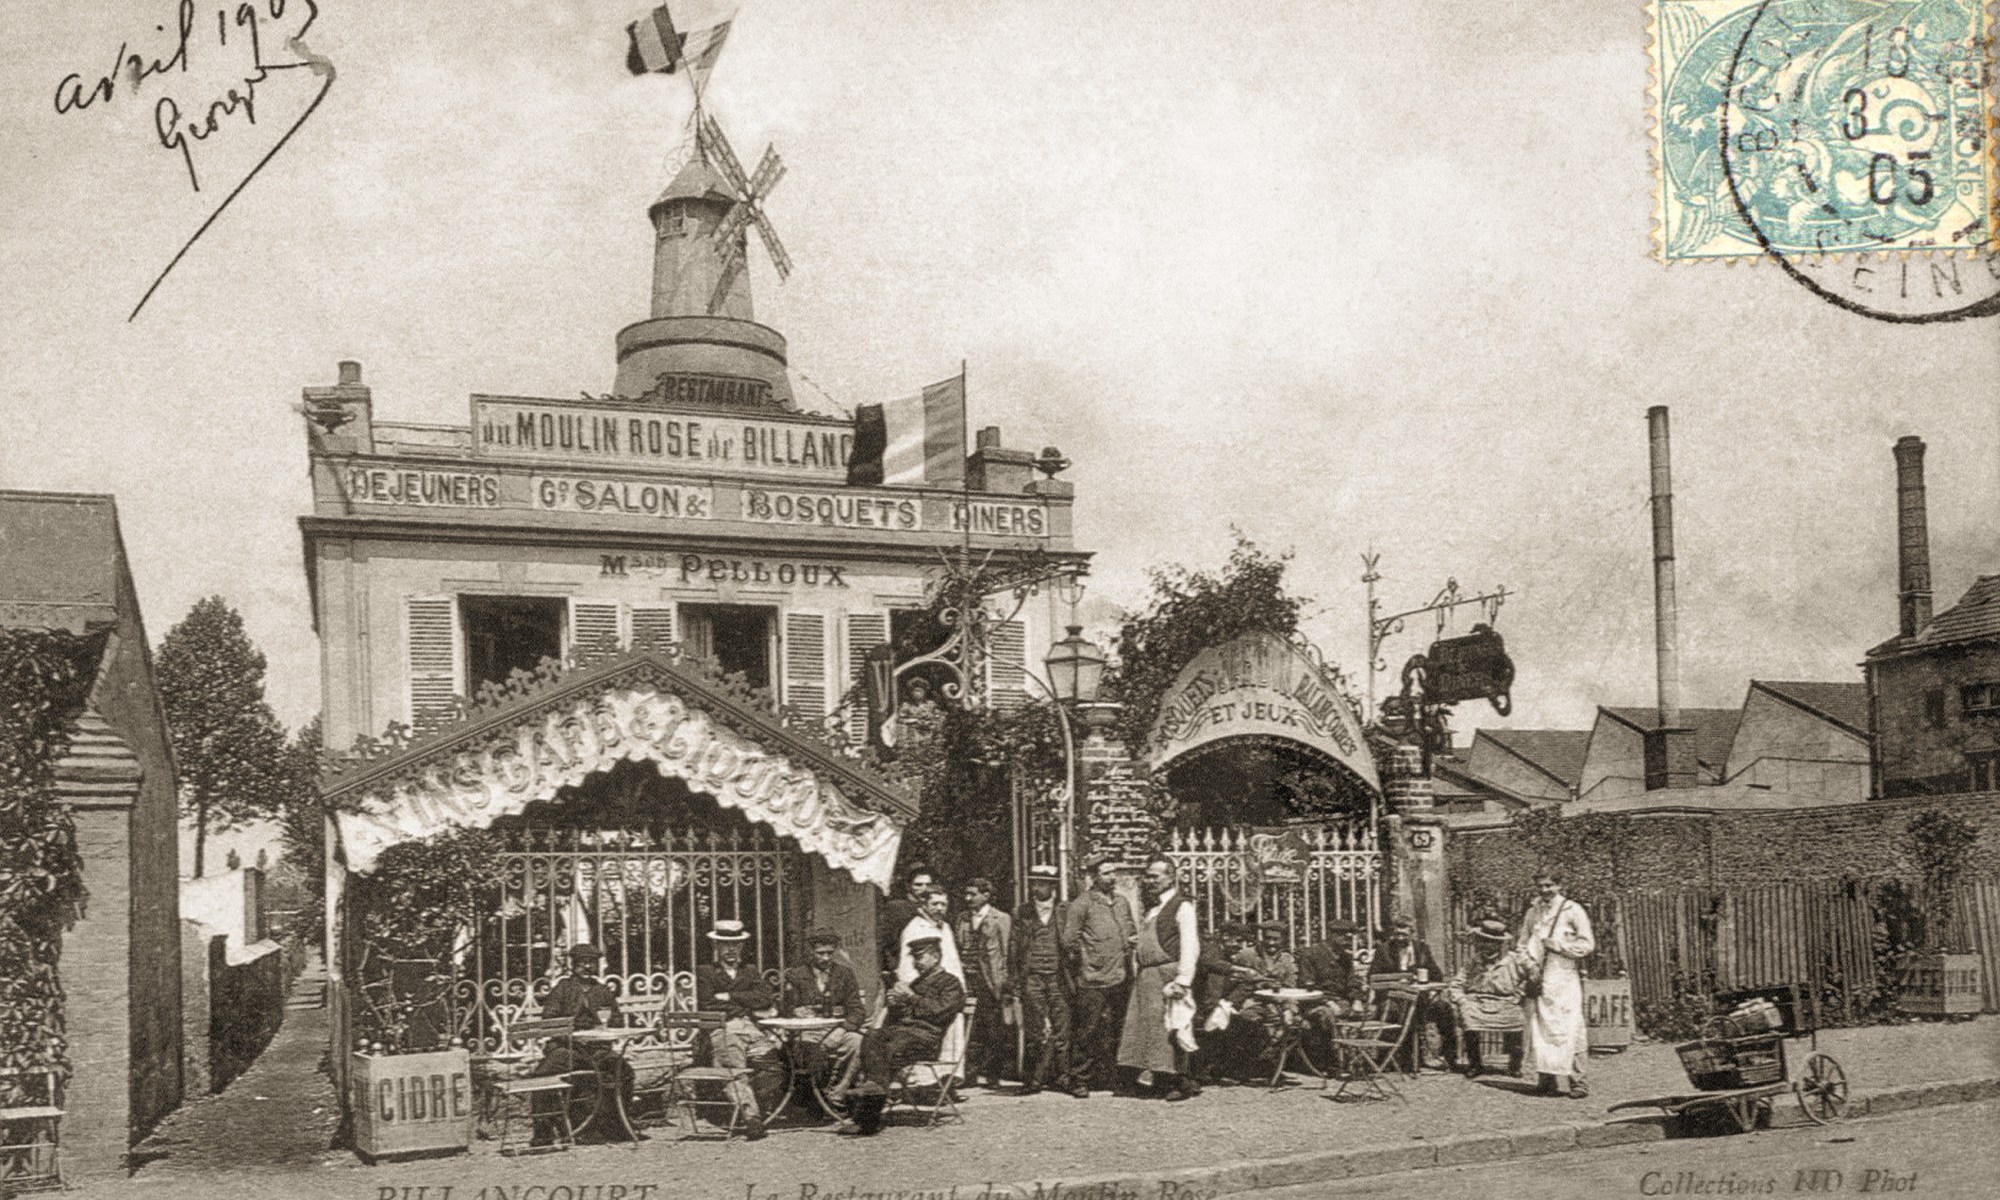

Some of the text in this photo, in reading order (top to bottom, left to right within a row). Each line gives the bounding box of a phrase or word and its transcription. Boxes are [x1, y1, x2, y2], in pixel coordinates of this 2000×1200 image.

[1868, 152, 1934, 206] 05
[516, 411, 620, 453] MOULIN
[629, 419, 701, 457] ROSE
[351, 469, 499, 506] DEJEUNERS
[576, 480, 681, 516] SALON
[747, 490, 917, 528] BOSQUETS
[953, 503, 1043, 535] DINERS
[680, 554, 850, 588] PELLOUX
[1210, 701, 1297, 727] ET JEUX
[379, 1072, 467, 1122] CIDRE
